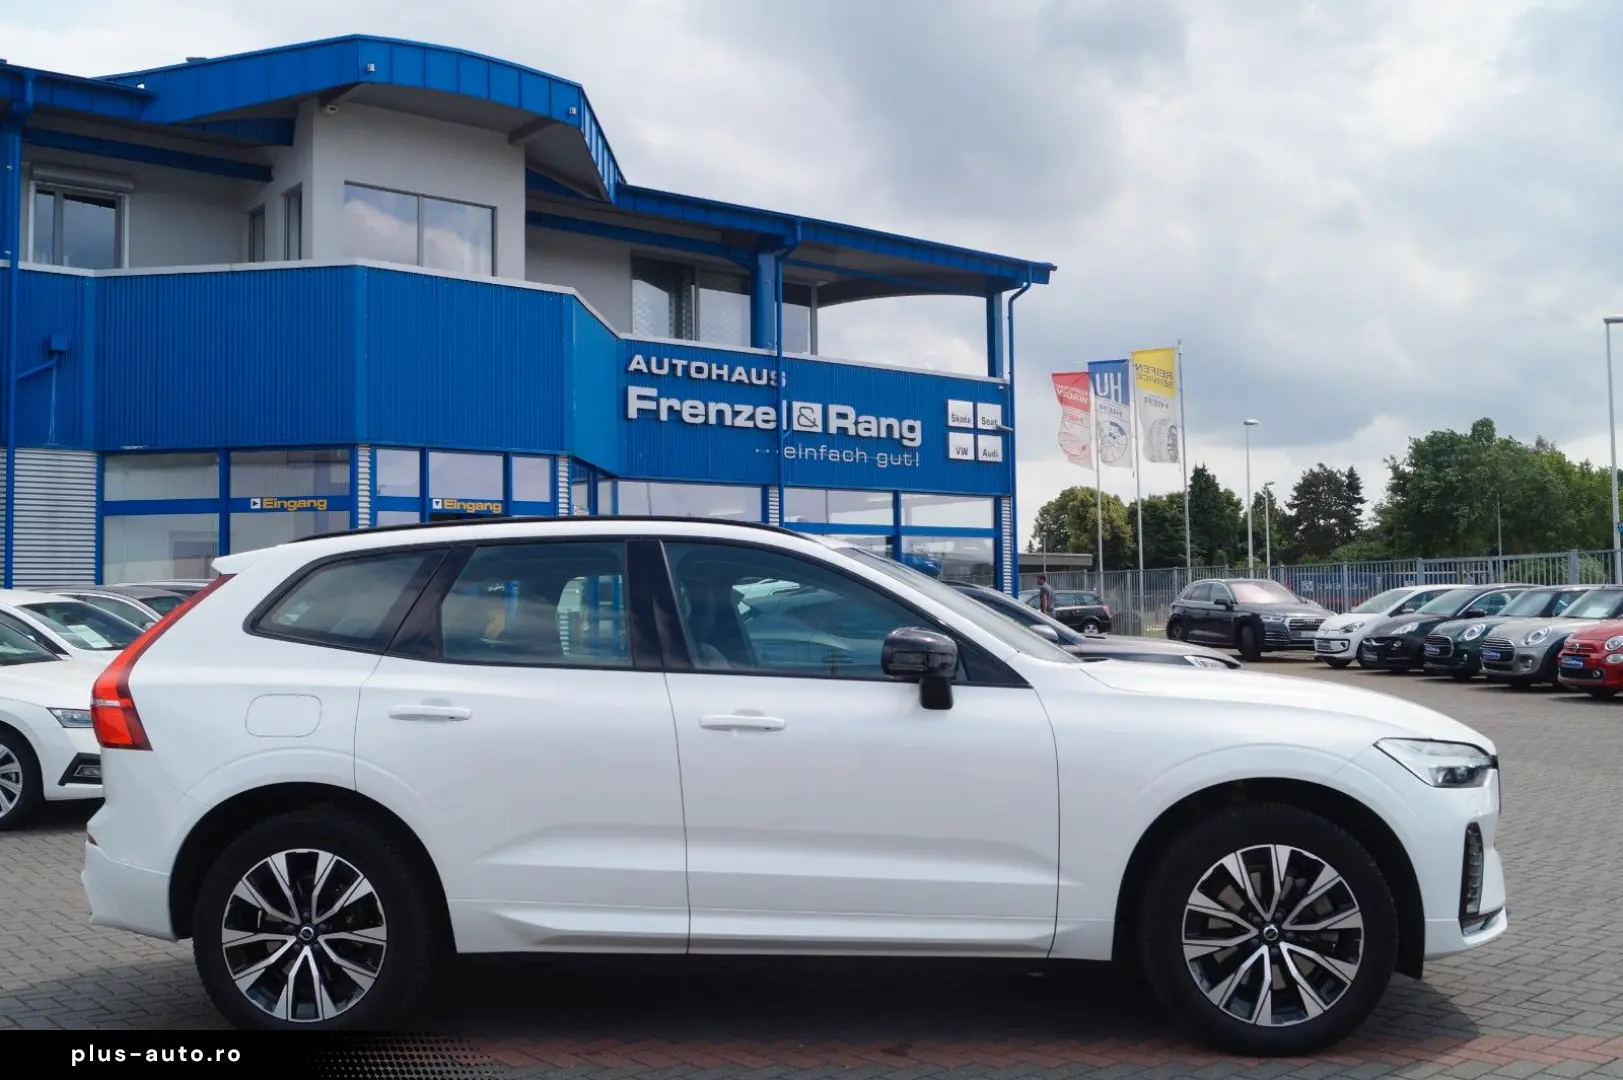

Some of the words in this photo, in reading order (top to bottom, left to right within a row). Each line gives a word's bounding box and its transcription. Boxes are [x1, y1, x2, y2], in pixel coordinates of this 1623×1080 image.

[628, 354, 786, 387] AUTOHAUS
[627, 385, 788, 431] Frenzel
[795, 404, 820, 430] &
[827, 404, 922, 447] Rang
[981, 416, 998, 426] Seat
[955, 446, 969, 456] VW
[982, 448, 999, 458] Audi
[876, 452, 919, 468] gut!
[262, 497, 328, 511] Eingang
[443, 498, 503, 513] Eingang
